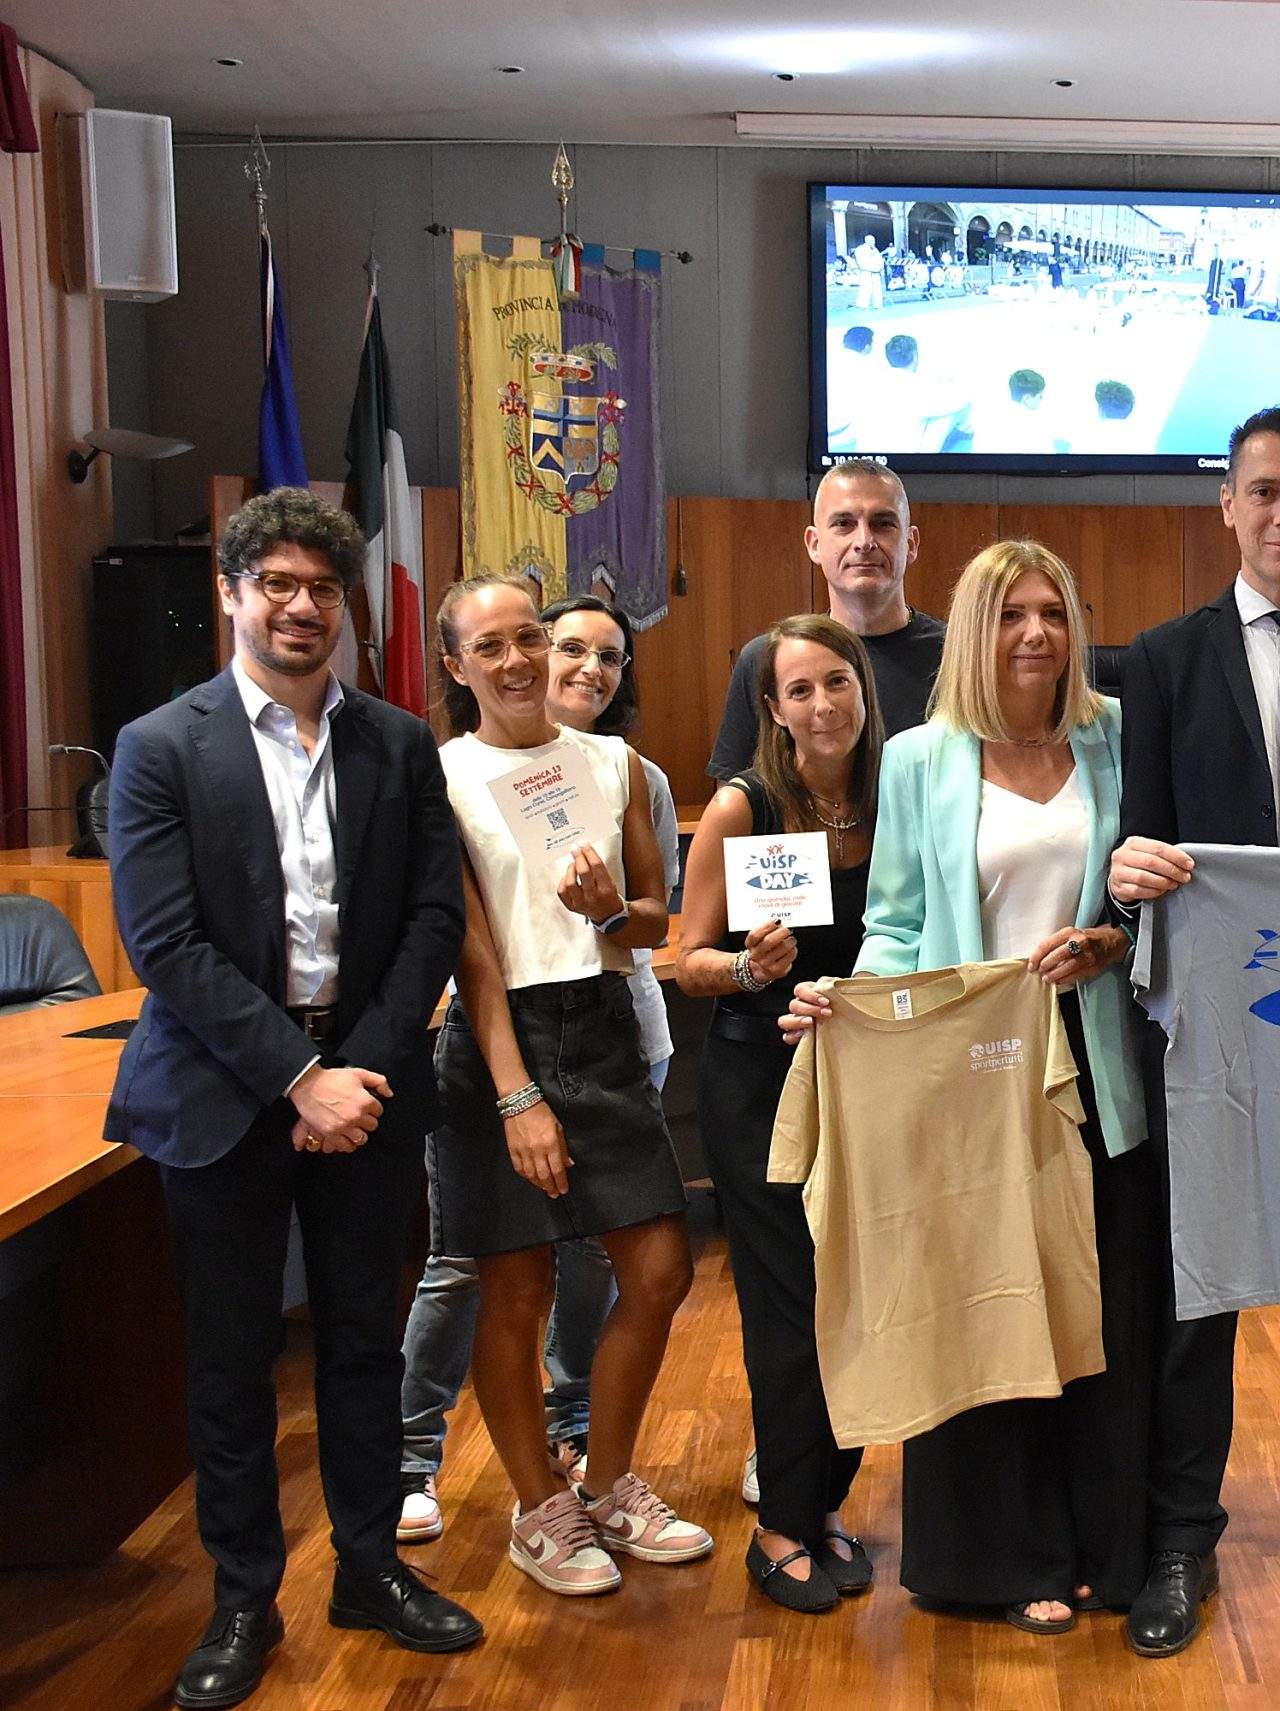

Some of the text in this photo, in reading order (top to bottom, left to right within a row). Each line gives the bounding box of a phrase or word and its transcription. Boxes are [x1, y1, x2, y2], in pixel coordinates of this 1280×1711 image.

[492, 296, 555, 321] PROVINCIA
[552, 764, 562, 774] 13
[519, 773, 563, 798] SETTEMBRE
[760, 872, 797, 889] DAY
[985, 1038, 1023, 1055] UISP
[969, 1053, 1024, 1072] sportpertutti
